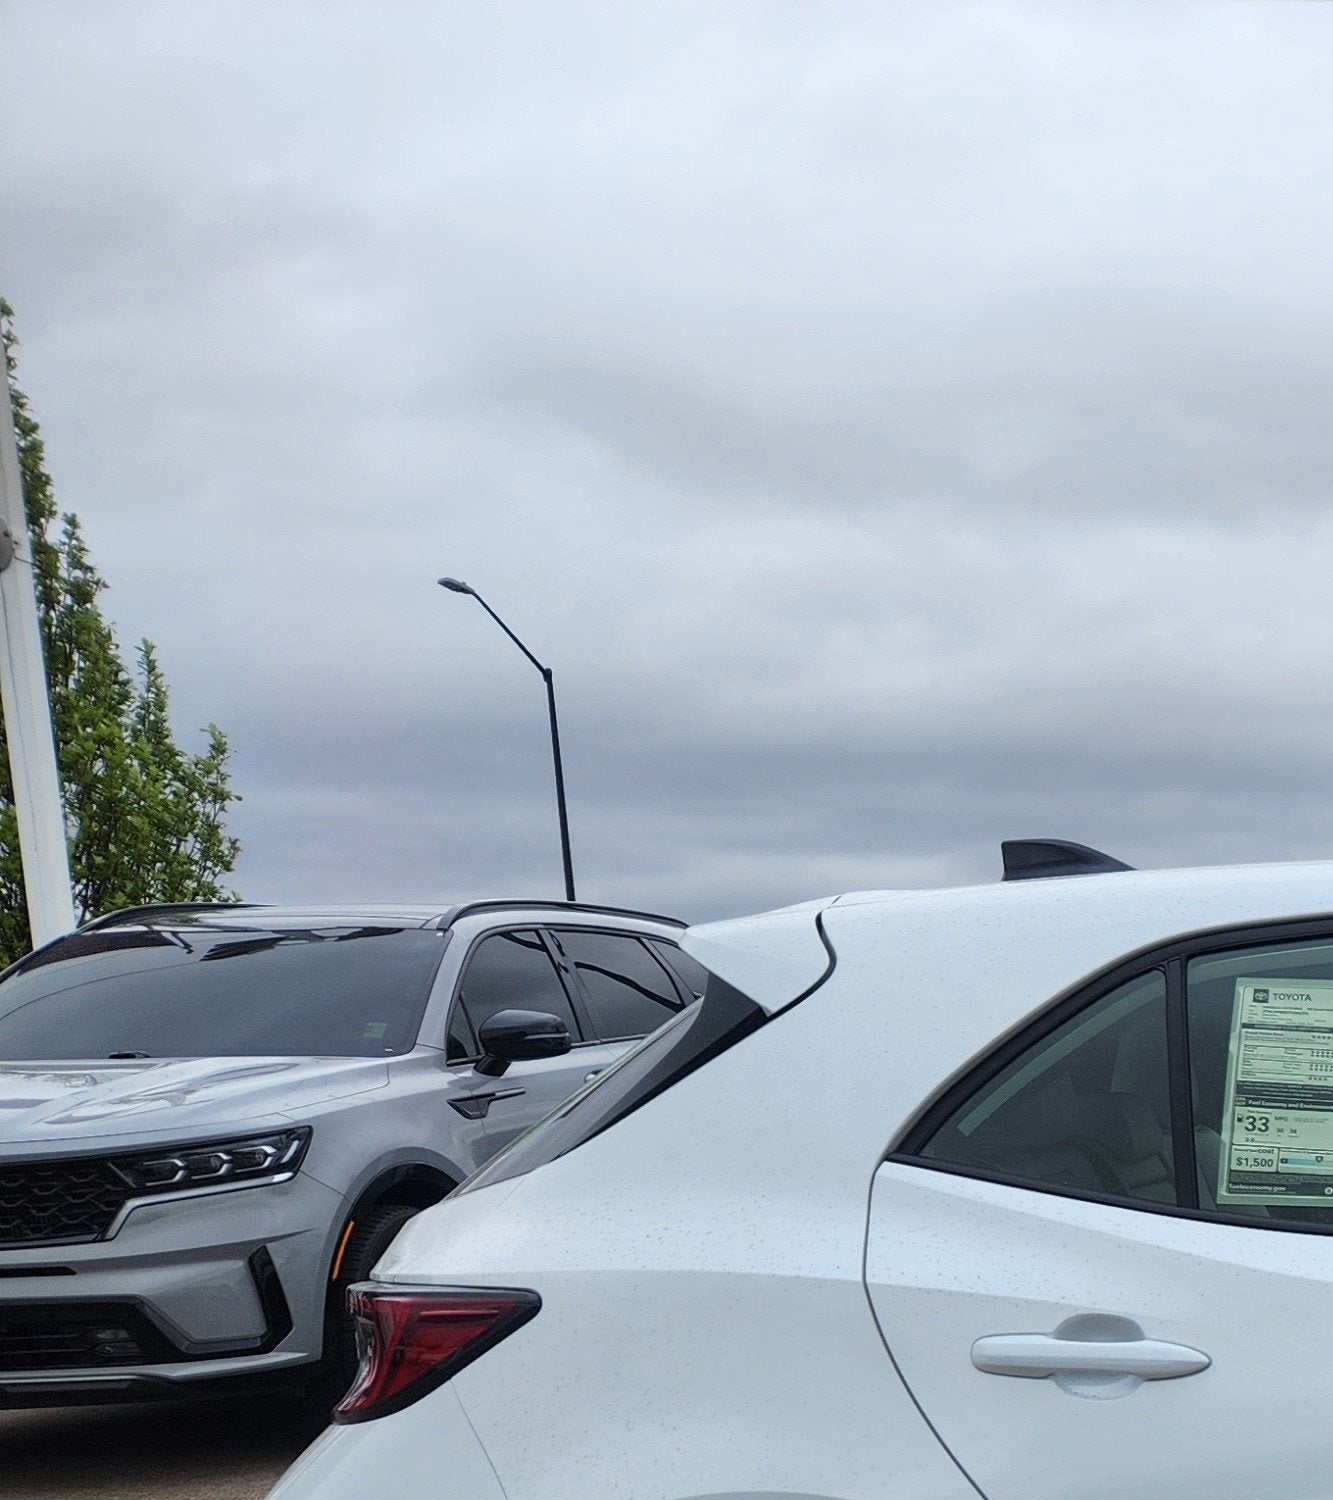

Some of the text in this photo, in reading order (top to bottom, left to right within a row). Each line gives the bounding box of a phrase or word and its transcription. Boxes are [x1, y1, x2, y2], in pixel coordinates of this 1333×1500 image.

[1272, 992, 1312, 1002] TOYOTA
[1245, 1115, 1270, 1133] 33
[1235, 1156, 1274, 1168] $1,500
